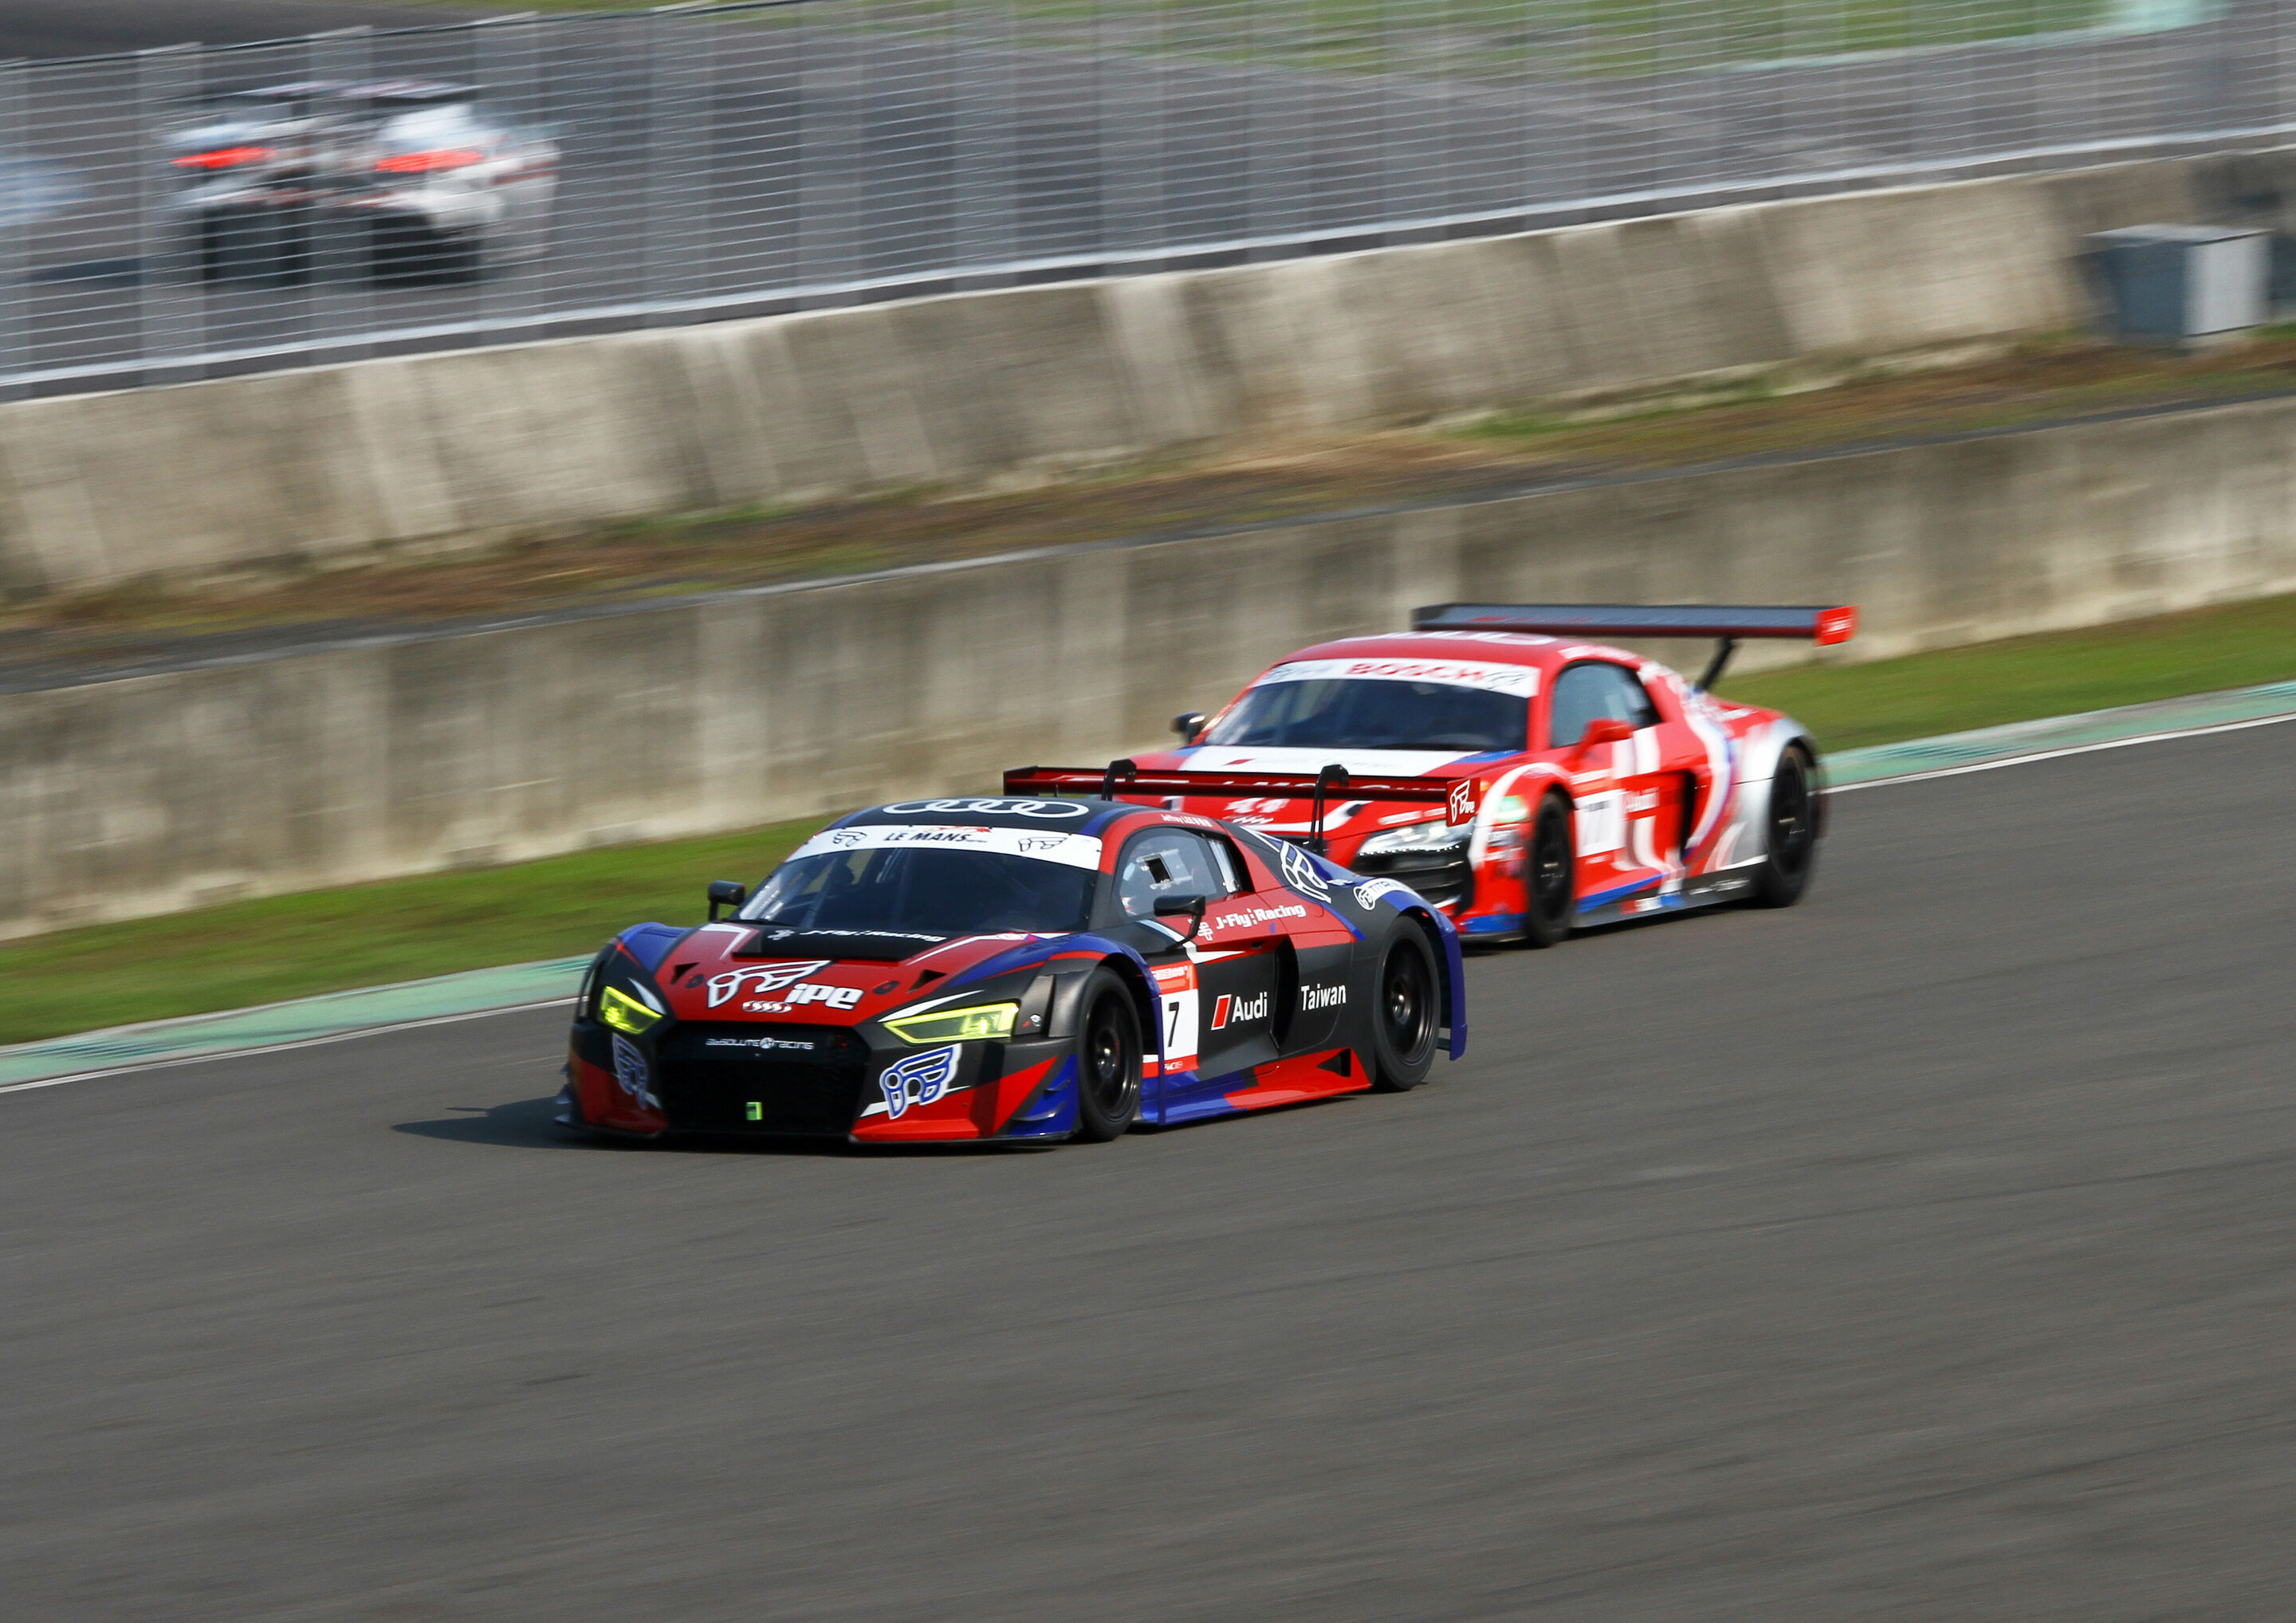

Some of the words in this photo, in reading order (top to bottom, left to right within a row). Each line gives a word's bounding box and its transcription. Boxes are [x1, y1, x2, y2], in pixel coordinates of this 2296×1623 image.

[1347, 662, 1485, 681] BOSCH
[883, 832, 908, 841] LE
[909, 832, 972, 842] MANS
[1253, 904, 1307, 922] Racing
[1232, 991, 1268, 1024] Audi
[1300, 983, 1347, 1011] Taiwan
[1167, 1001, 1180, 1048] 7
